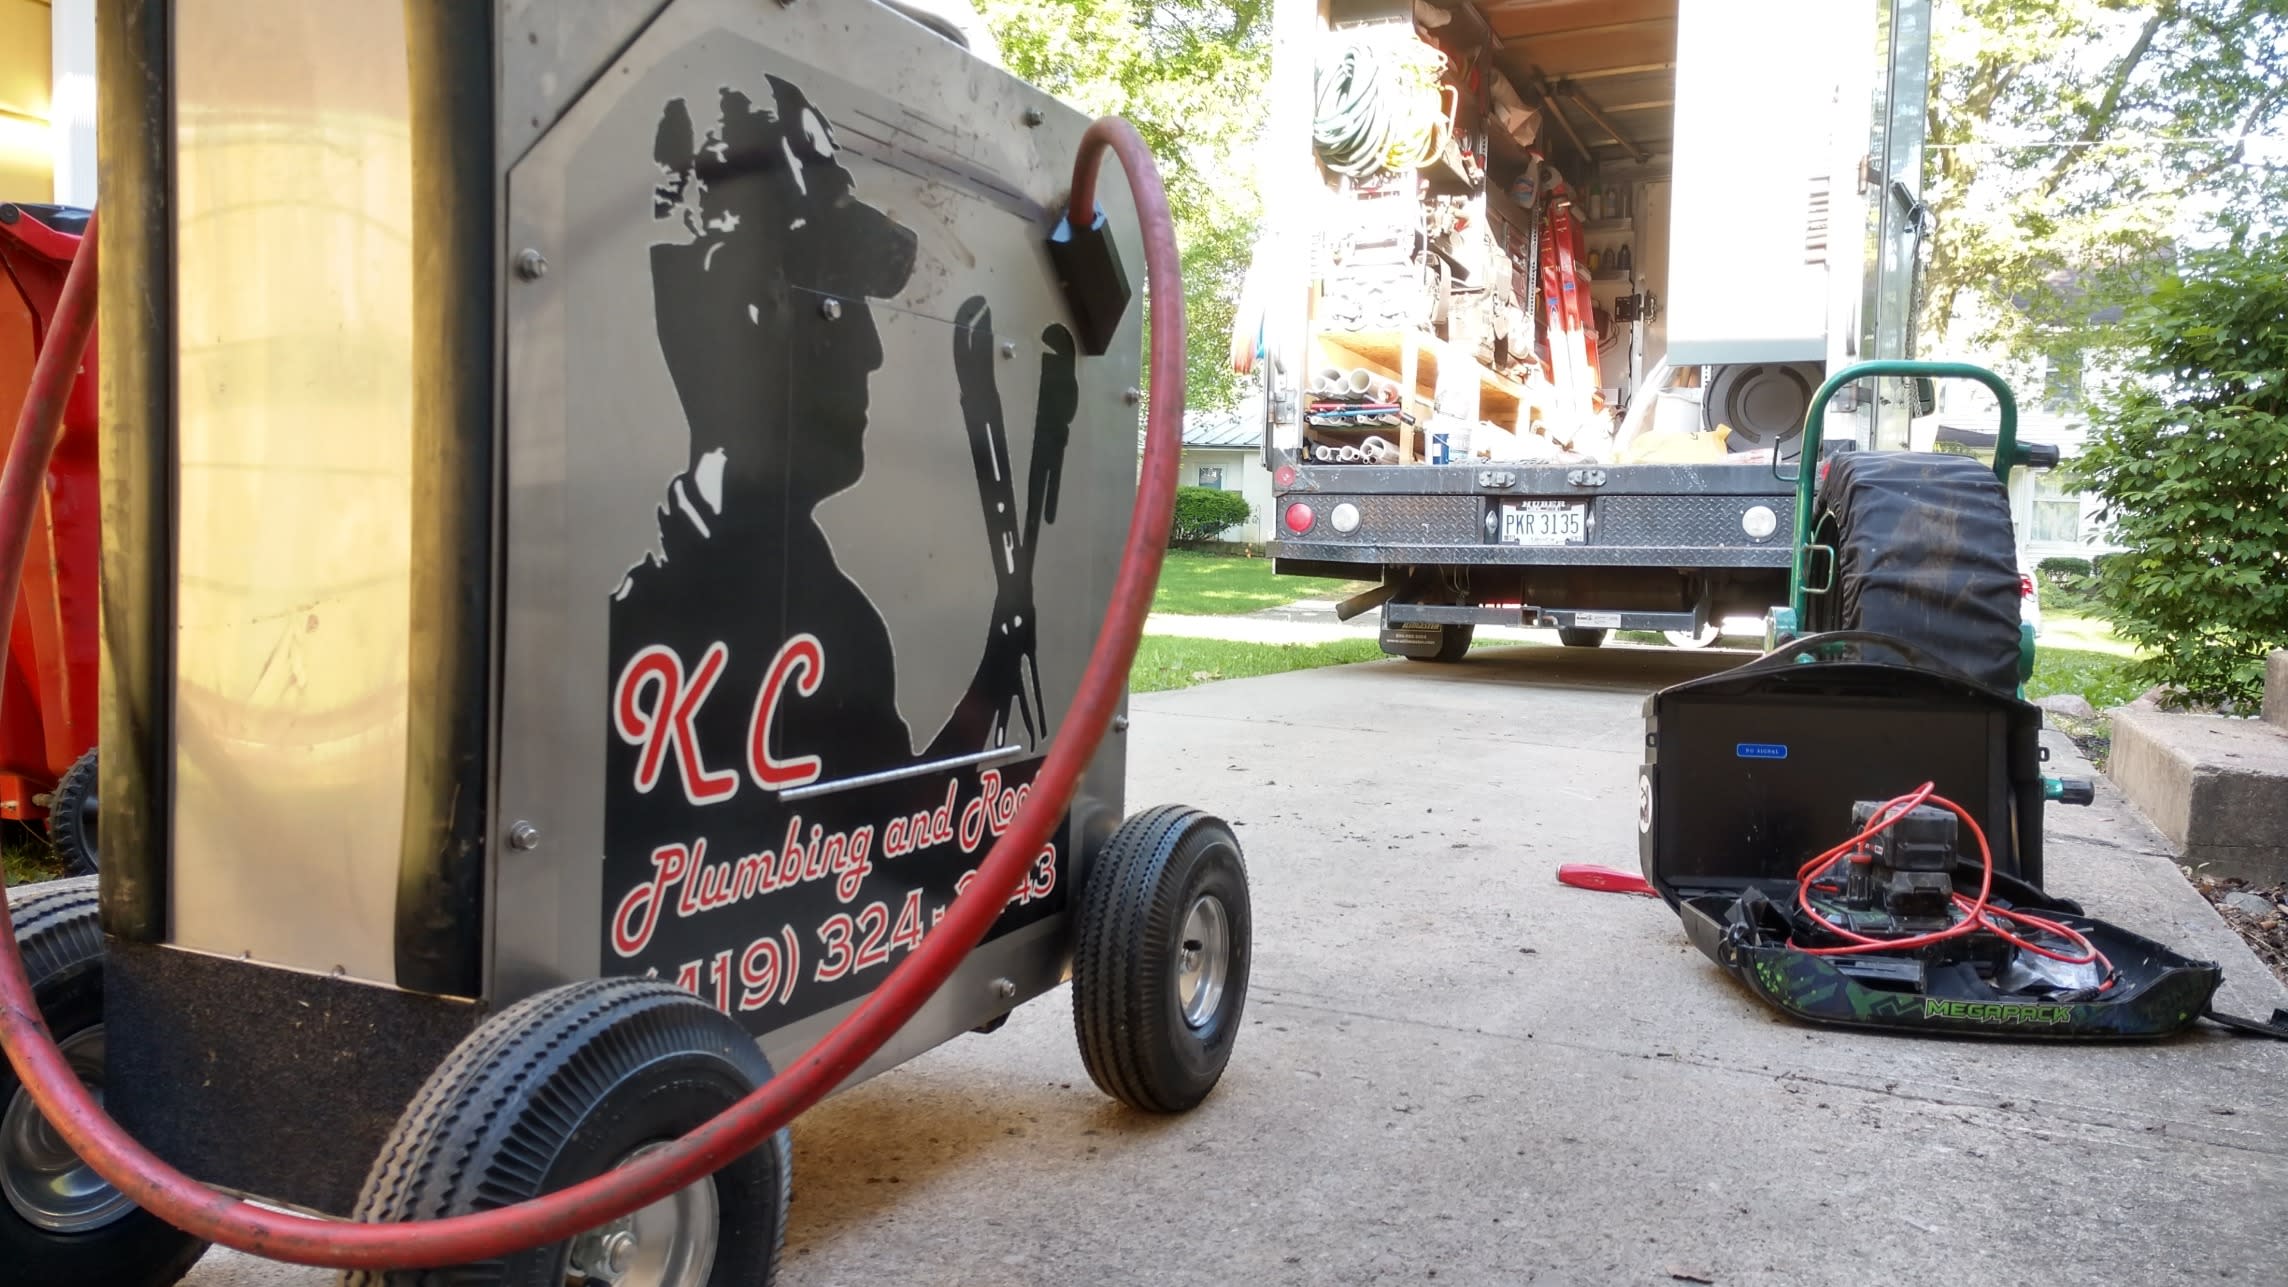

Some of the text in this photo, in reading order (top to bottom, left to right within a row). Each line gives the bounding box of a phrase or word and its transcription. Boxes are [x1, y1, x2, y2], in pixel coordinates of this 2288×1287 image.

[1506, 513, 1579, 535] PKR 3135
[611, 769, 1040, 957] Plumbing and Roo
[646, 923, 800, 1016] 419)
[1924, 998, 2074, 1026] MEGAPACK
